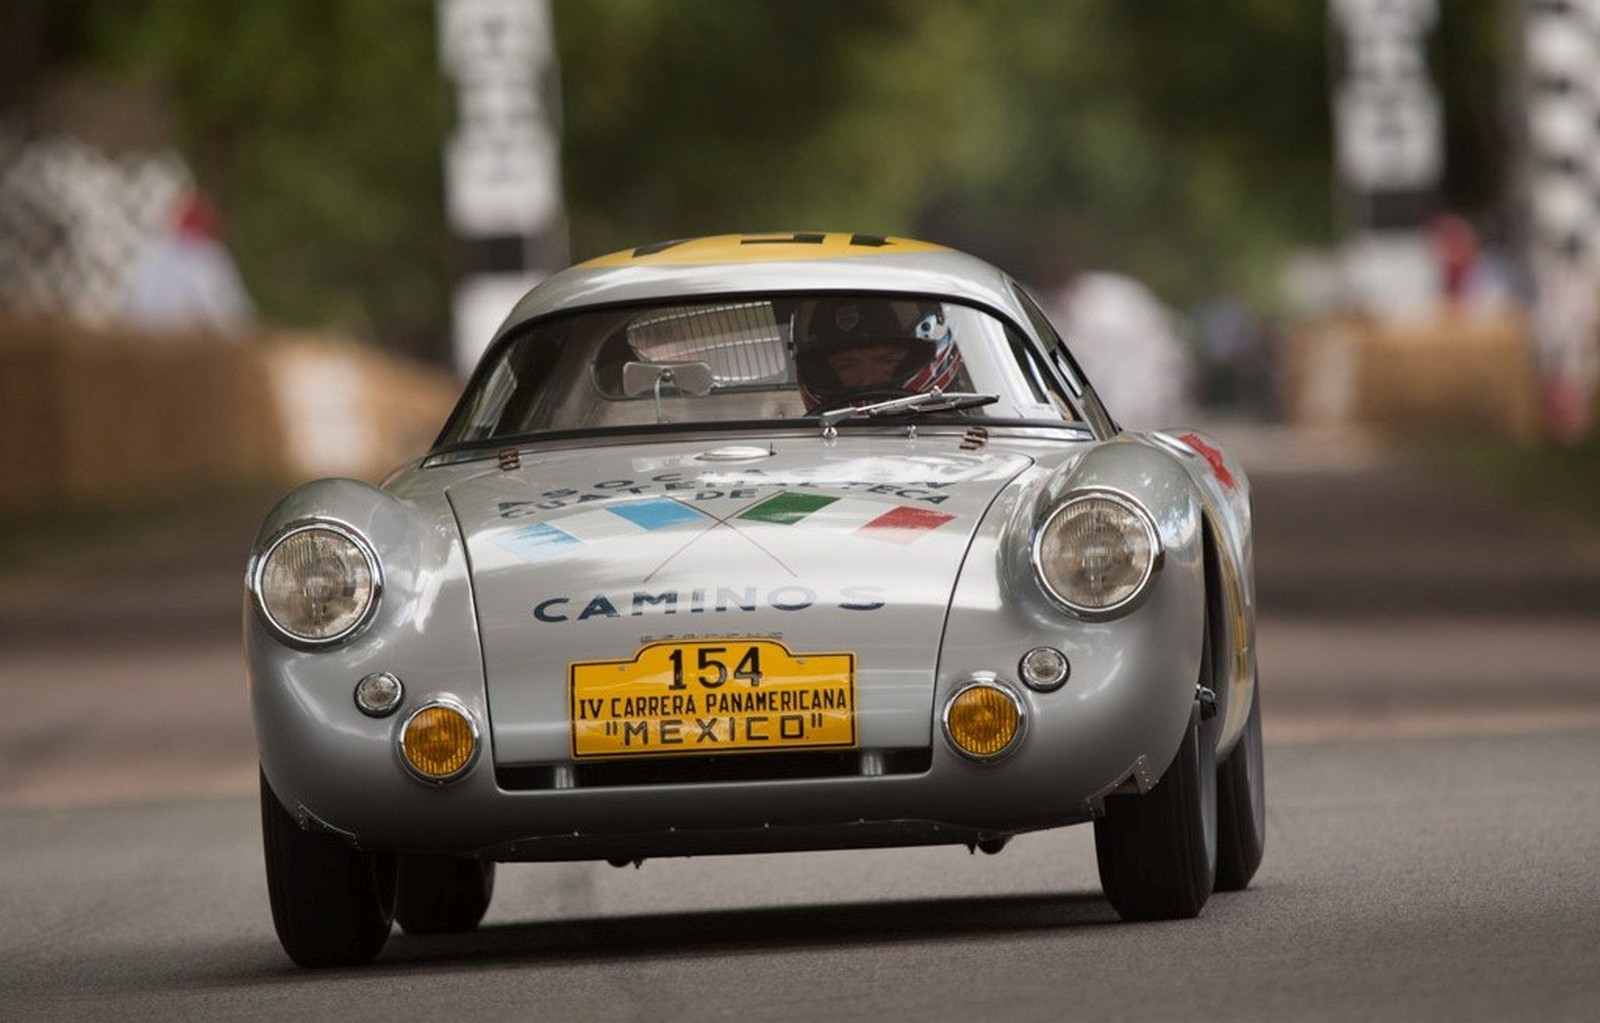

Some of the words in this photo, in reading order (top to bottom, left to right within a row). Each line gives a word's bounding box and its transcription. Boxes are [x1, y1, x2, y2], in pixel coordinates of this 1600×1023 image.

[695, 488, 759, 501] DE
[533, 585, 886, 623] CAMINOS
[668, 646, 763, 691] 154
[579, 698, 604, 720] IV
[611, 694, 697, 718] CARRERA
[706, 688, 847, 714] PANAMERICANA
[605, 713, 823, 746] "MEXICO"
